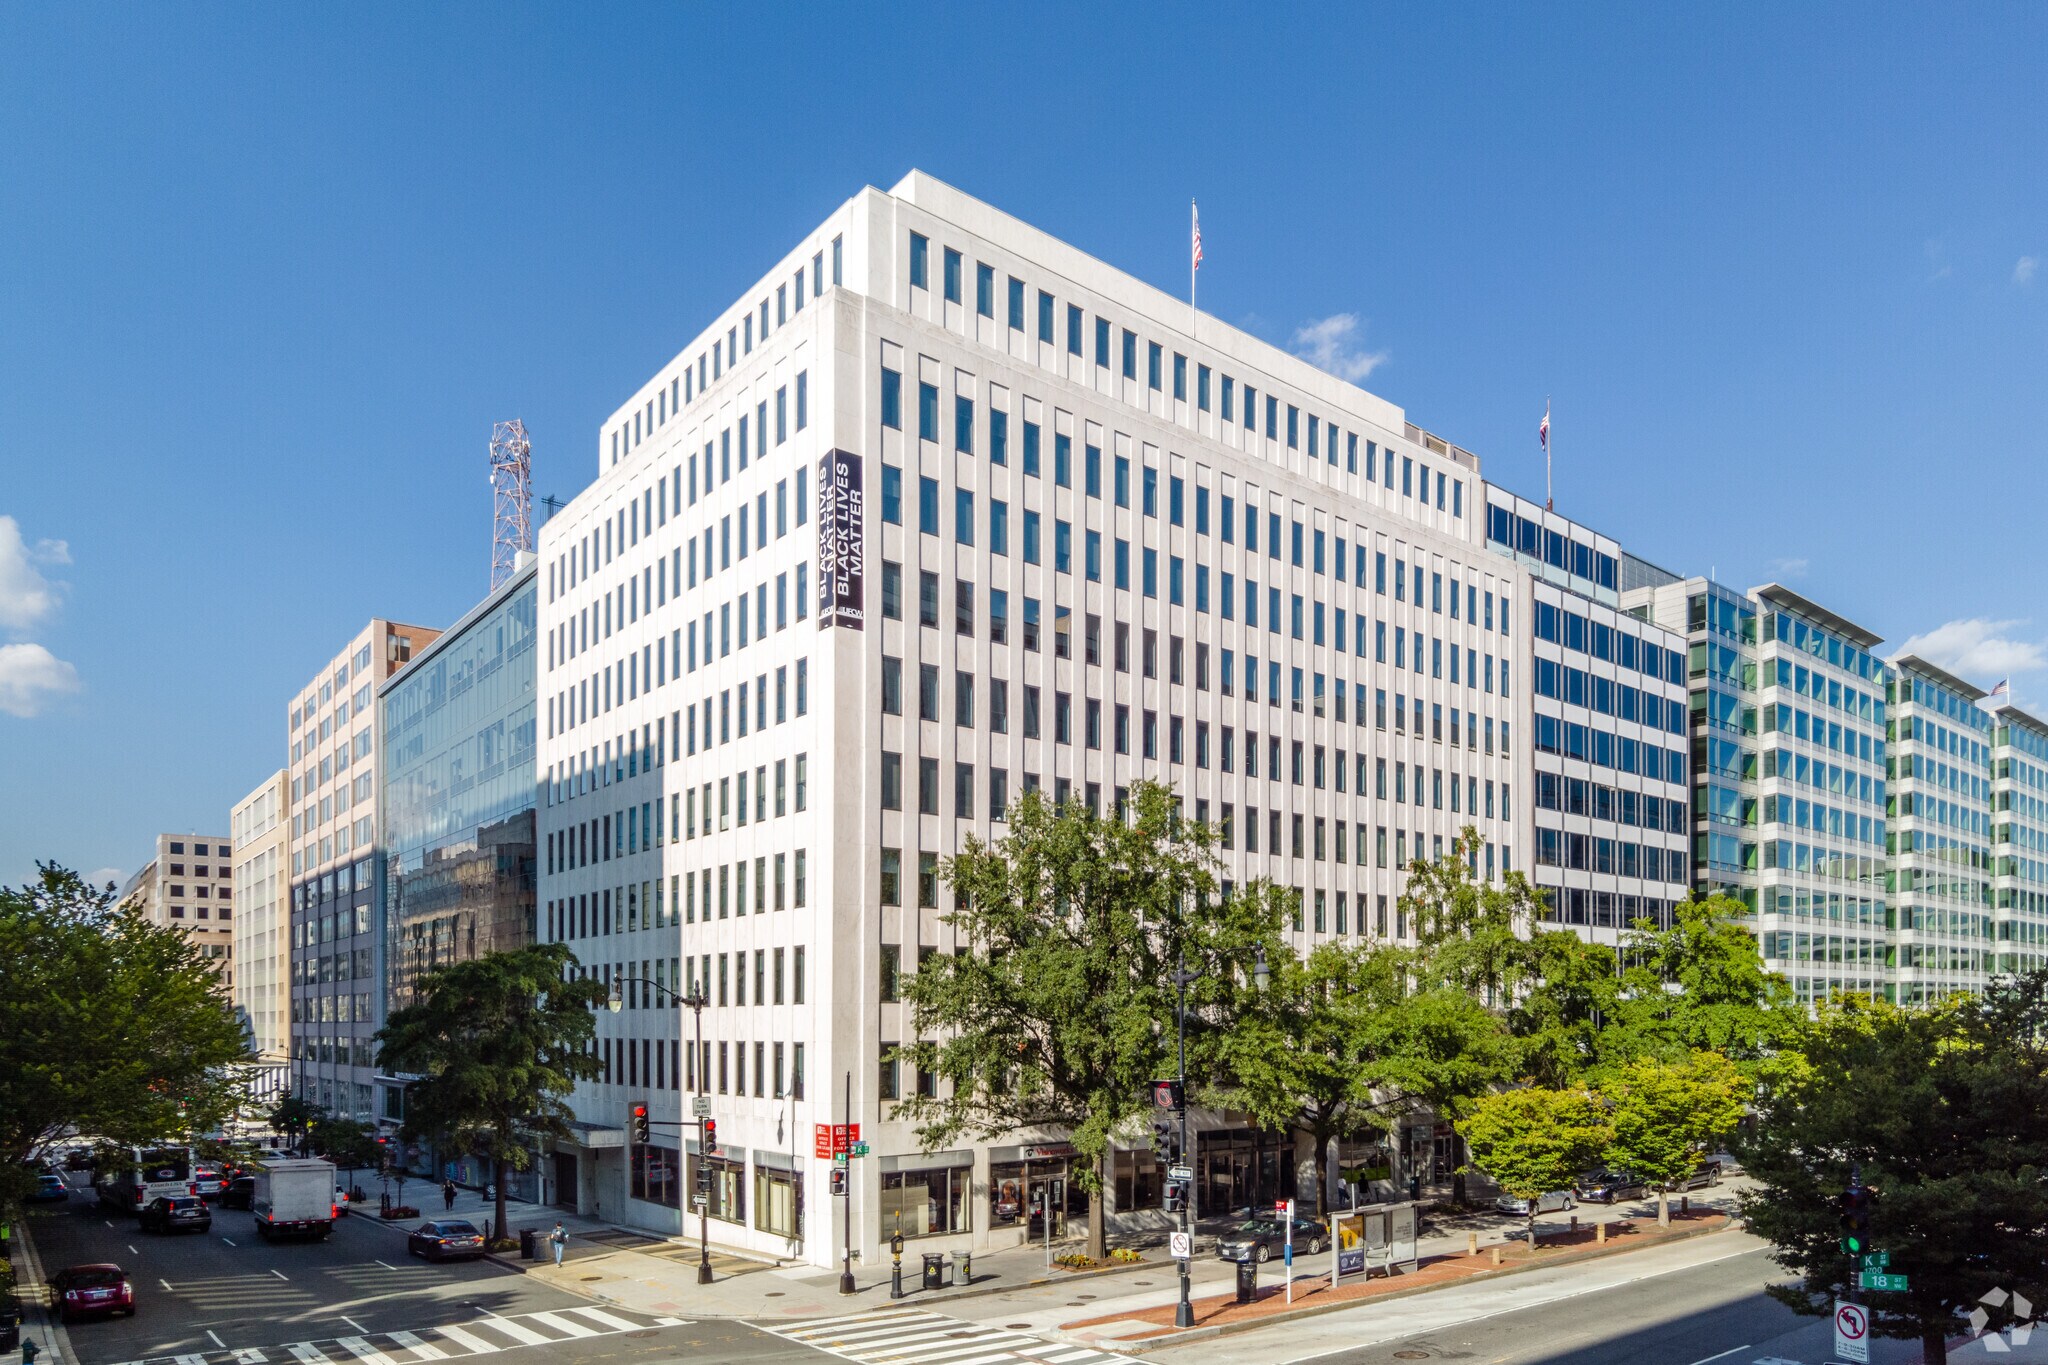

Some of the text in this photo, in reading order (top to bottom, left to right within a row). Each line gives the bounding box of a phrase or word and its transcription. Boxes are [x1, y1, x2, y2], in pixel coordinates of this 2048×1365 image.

[836, 463, 849, 596] BLACK LIVES
[850, 489, 862, 576] MATTER
[1865, 1255, 1873, 1266] K
[1871, 1275, 1887, 1287] 18
